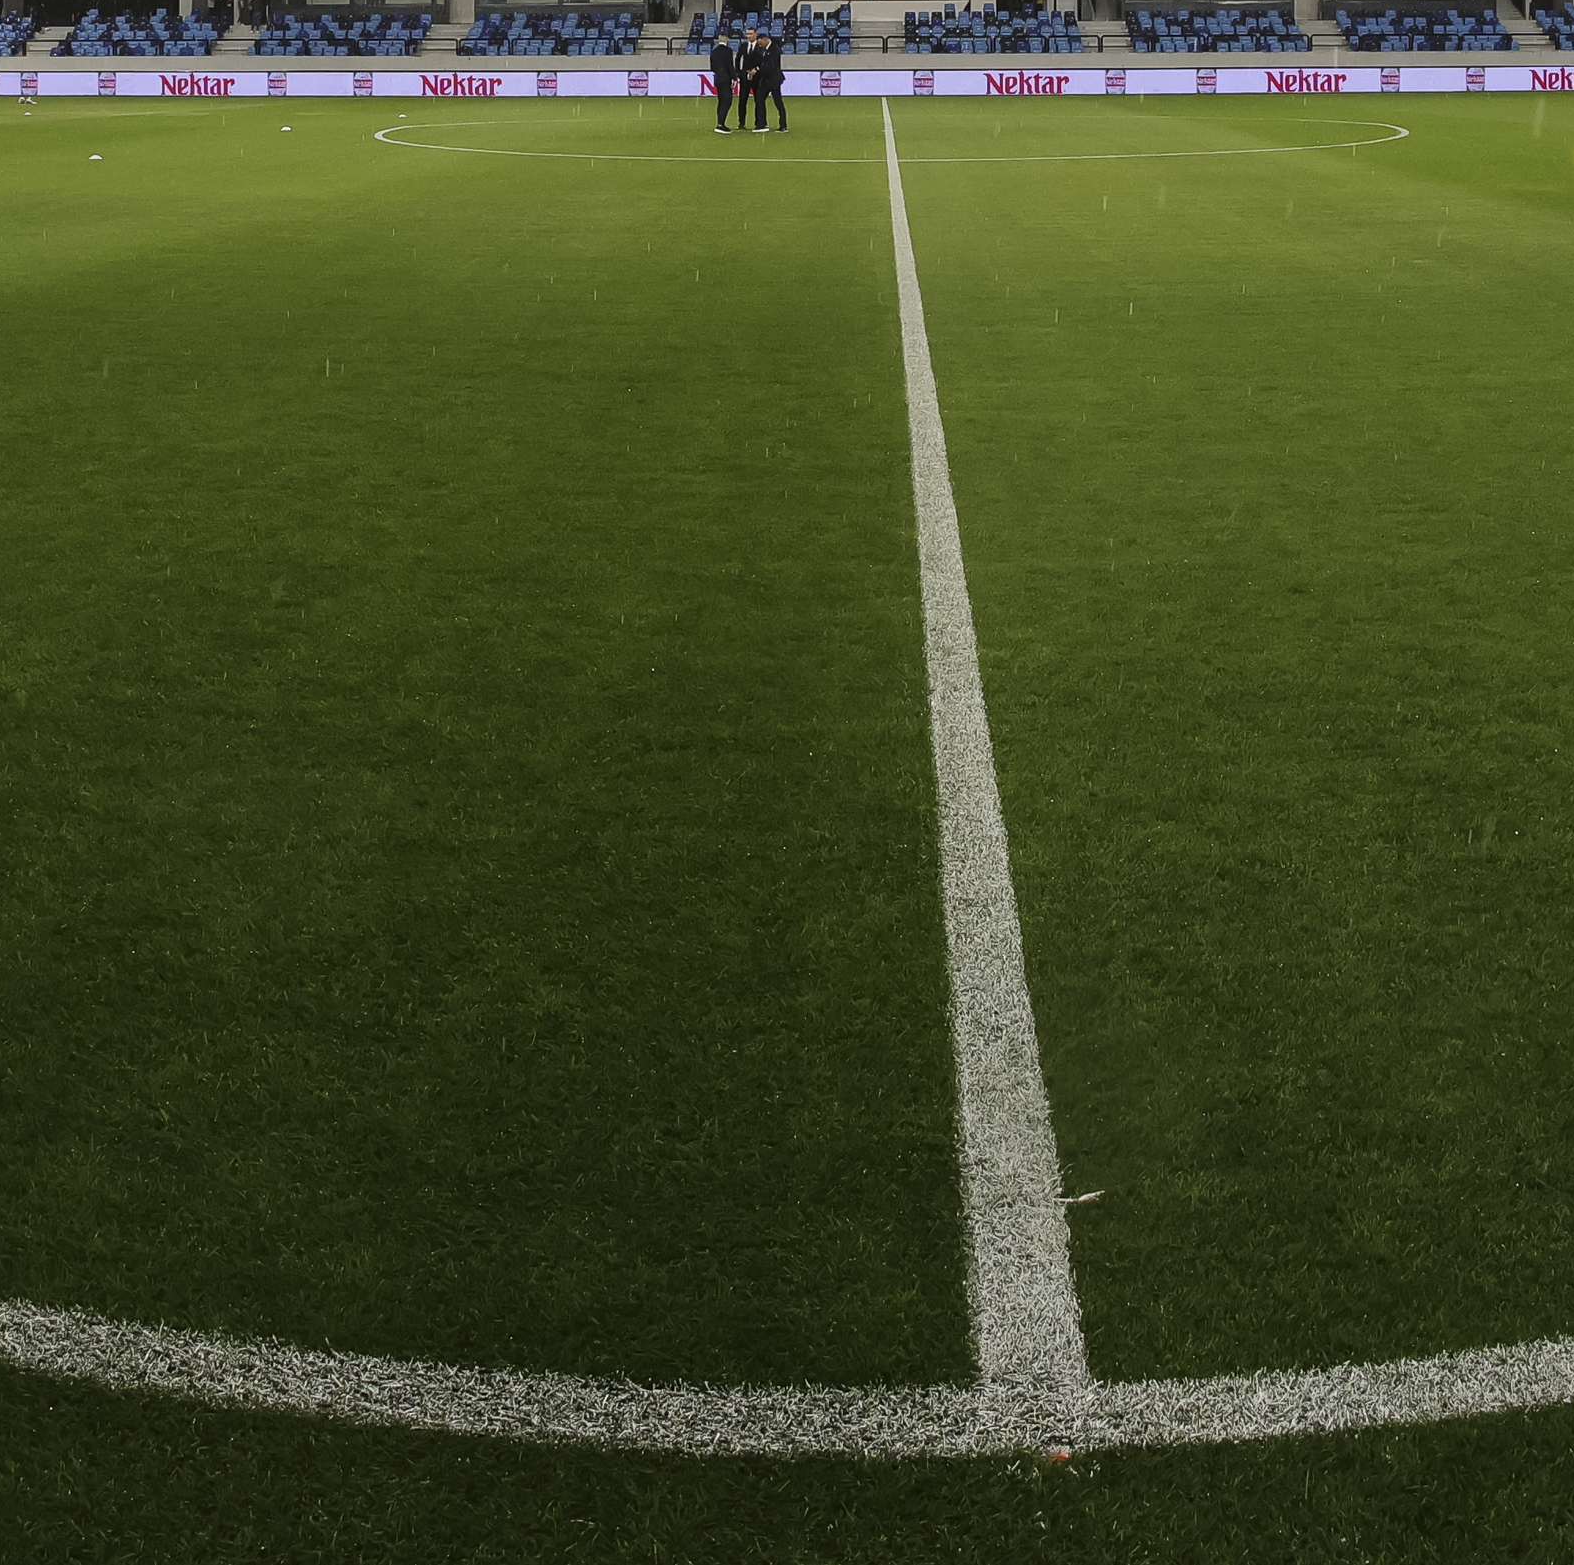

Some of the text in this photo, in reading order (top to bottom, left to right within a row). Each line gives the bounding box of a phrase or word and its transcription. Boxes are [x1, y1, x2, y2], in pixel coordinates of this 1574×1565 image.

[158, 72, 236, 96] Nektar
[419, 72, 503, 96] Nektar
[983, 70, 1070, 95] Nektar
[1264, 68, 1347, 93] Nektar
